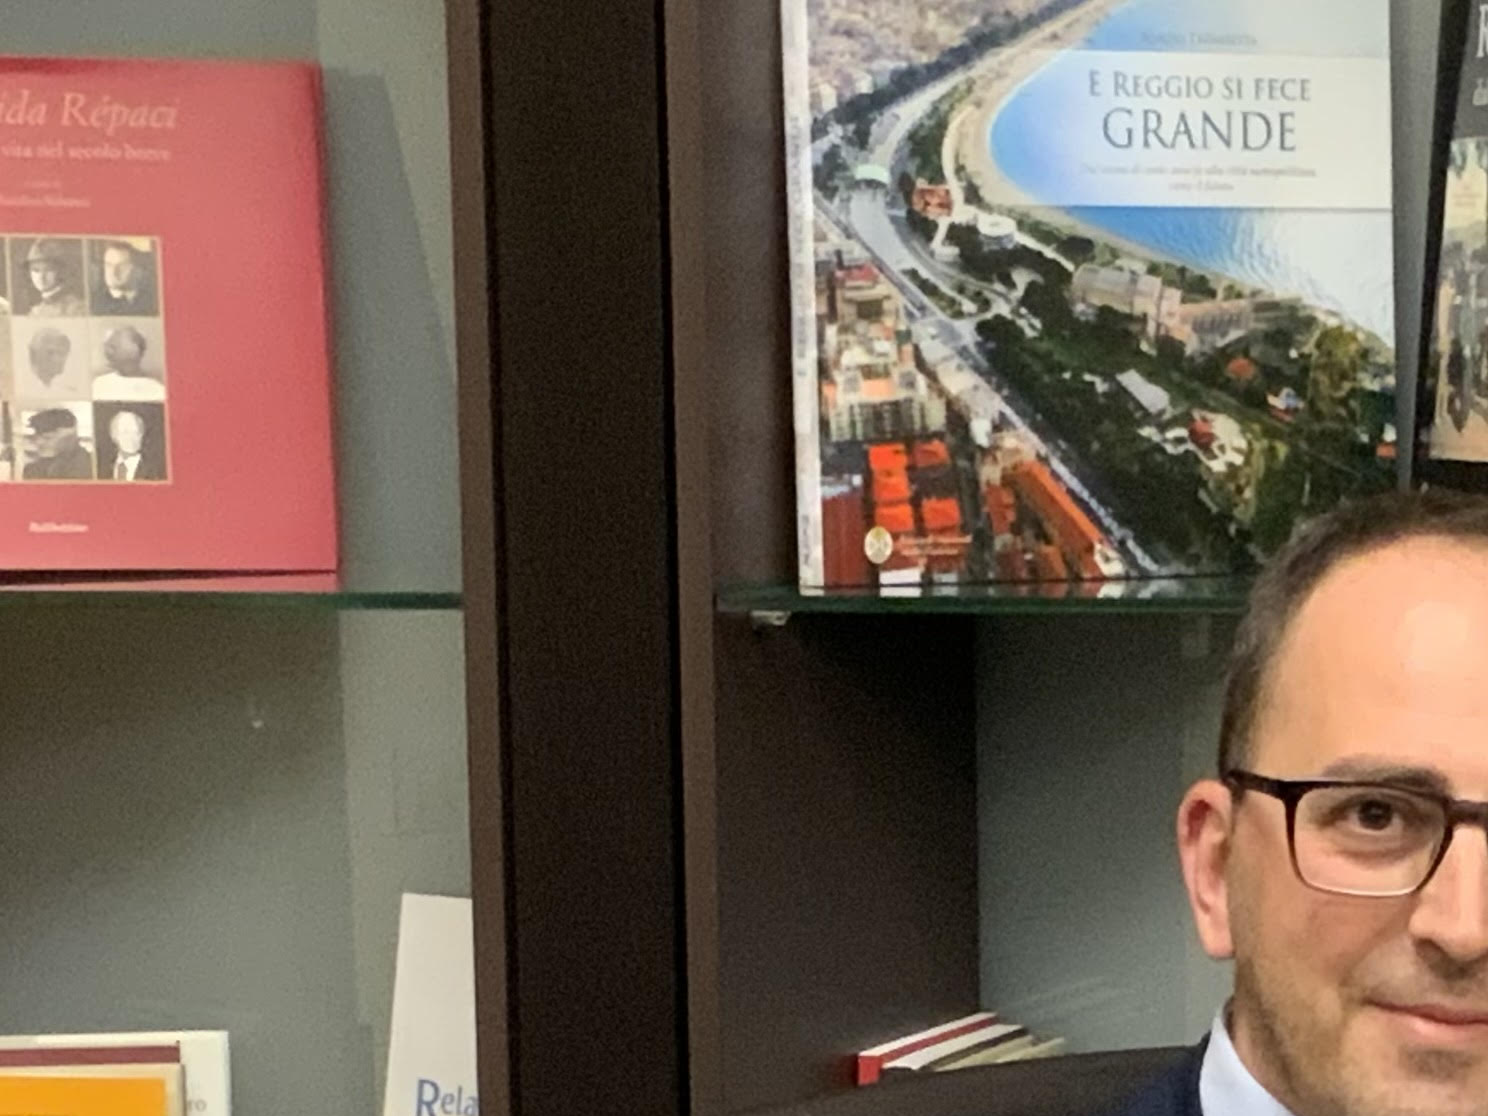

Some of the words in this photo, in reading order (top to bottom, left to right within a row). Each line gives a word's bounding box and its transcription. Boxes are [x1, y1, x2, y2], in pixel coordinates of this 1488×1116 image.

[1089, 69, 1102, 97] E
[1254, 78, 1312, 102] FECE
[1103, 106, 1297, 152] GRANDE
